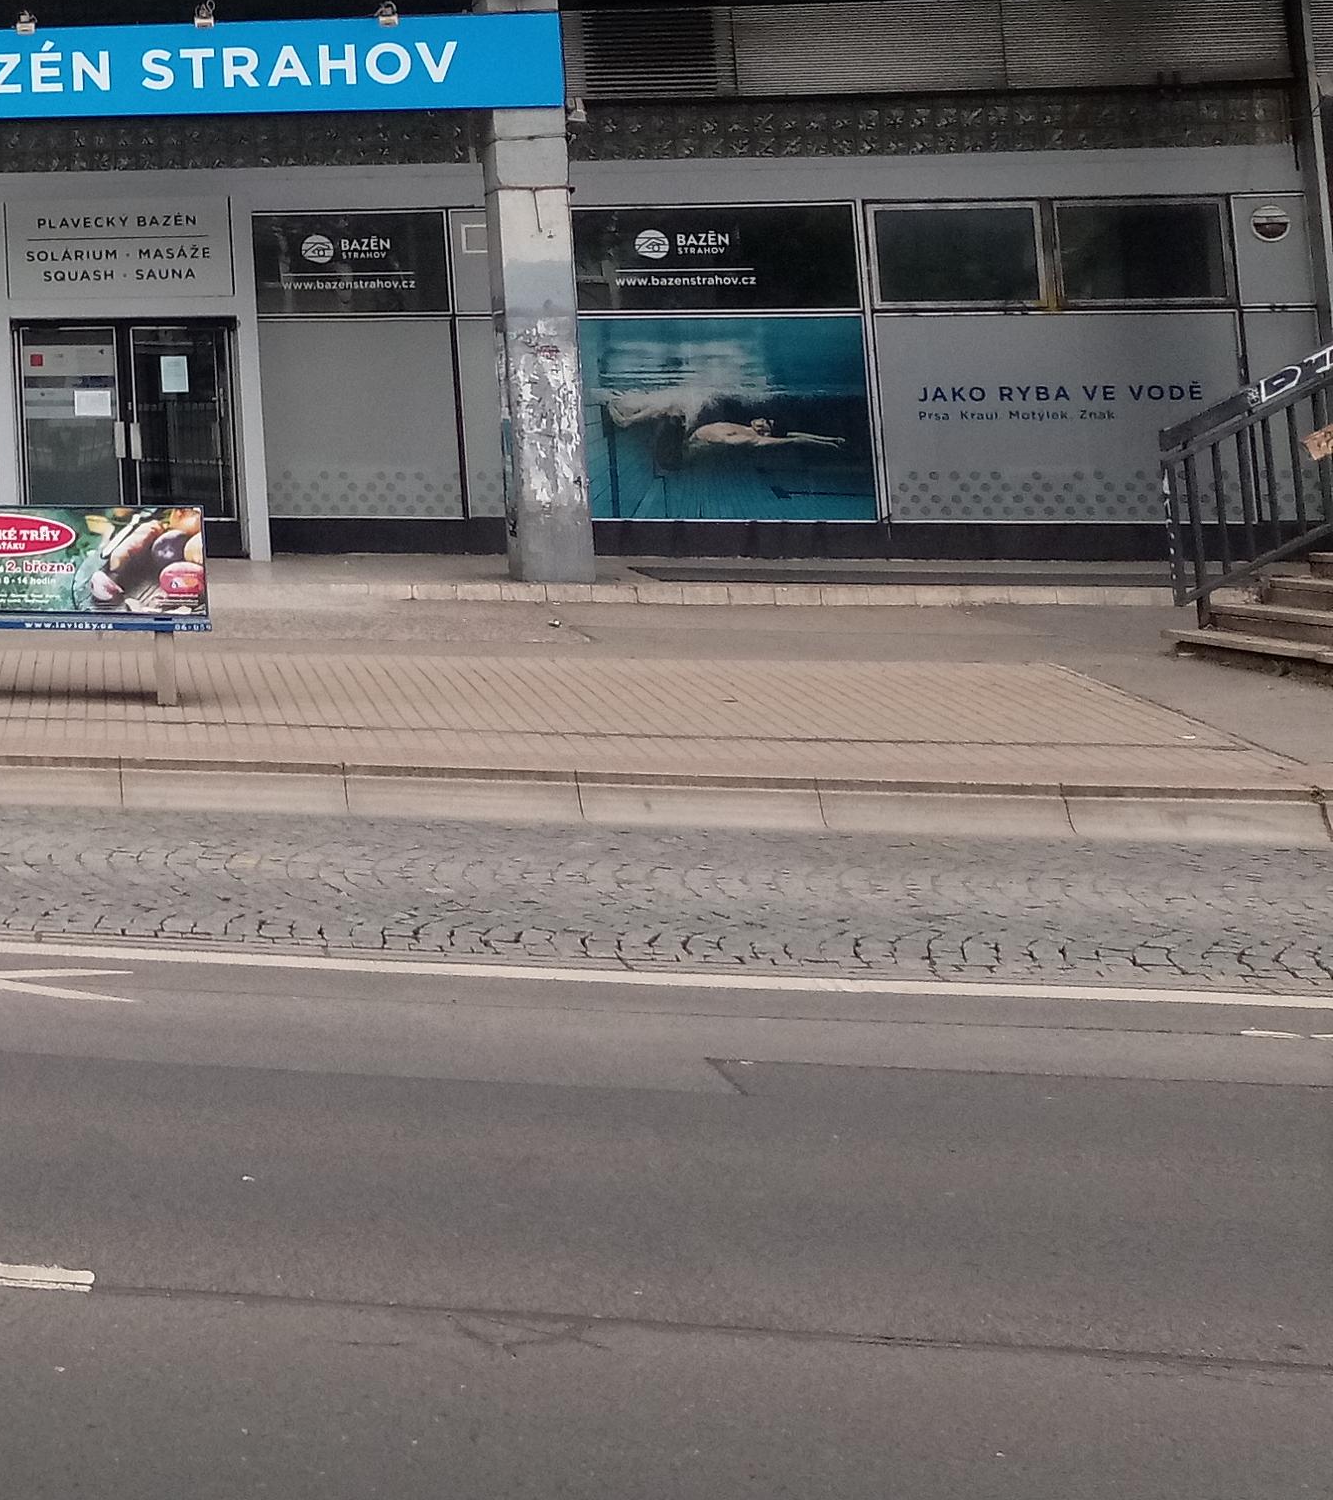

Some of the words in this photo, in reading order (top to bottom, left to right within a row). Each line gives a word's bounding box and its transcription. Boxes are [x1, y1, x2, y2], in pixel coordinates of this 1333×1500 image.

[141, 40, 458, 91] STRAHOV
[37, 214, 129, 229] PLAVECKÝ
[136, 212, 197, 227] BAZÉN
[341, 235, 391, 251] BAZÉN
[676, 230, 730, 246] BAZÉN
[26, 248, 118, 262] SOLÁRIUM
[138, 244, 211, 259] MASÁŽE
[342, 251, 387, 259] STRAHOV
[677, 247, 725, 255] STRAHOV
[43, 270, 115, 283] SQUASH
[135, 267, 196, 281] SAUNA
[615, 275, 757, 287] www.bazenstrahov.cz
[283, 279, 416, 290] www.bazenstrahov.cz
[918, 386, 986, 402] JAKO
[999, 385, 1070, 401] RYBA
[1082, 385, 1116, 401] VE
[1129, 381, 1203, 401] VODĚ
[22, 560, 76, 574] března
[17, 576, 28, 584] 14
[30, 575, 57, 584] hodin
